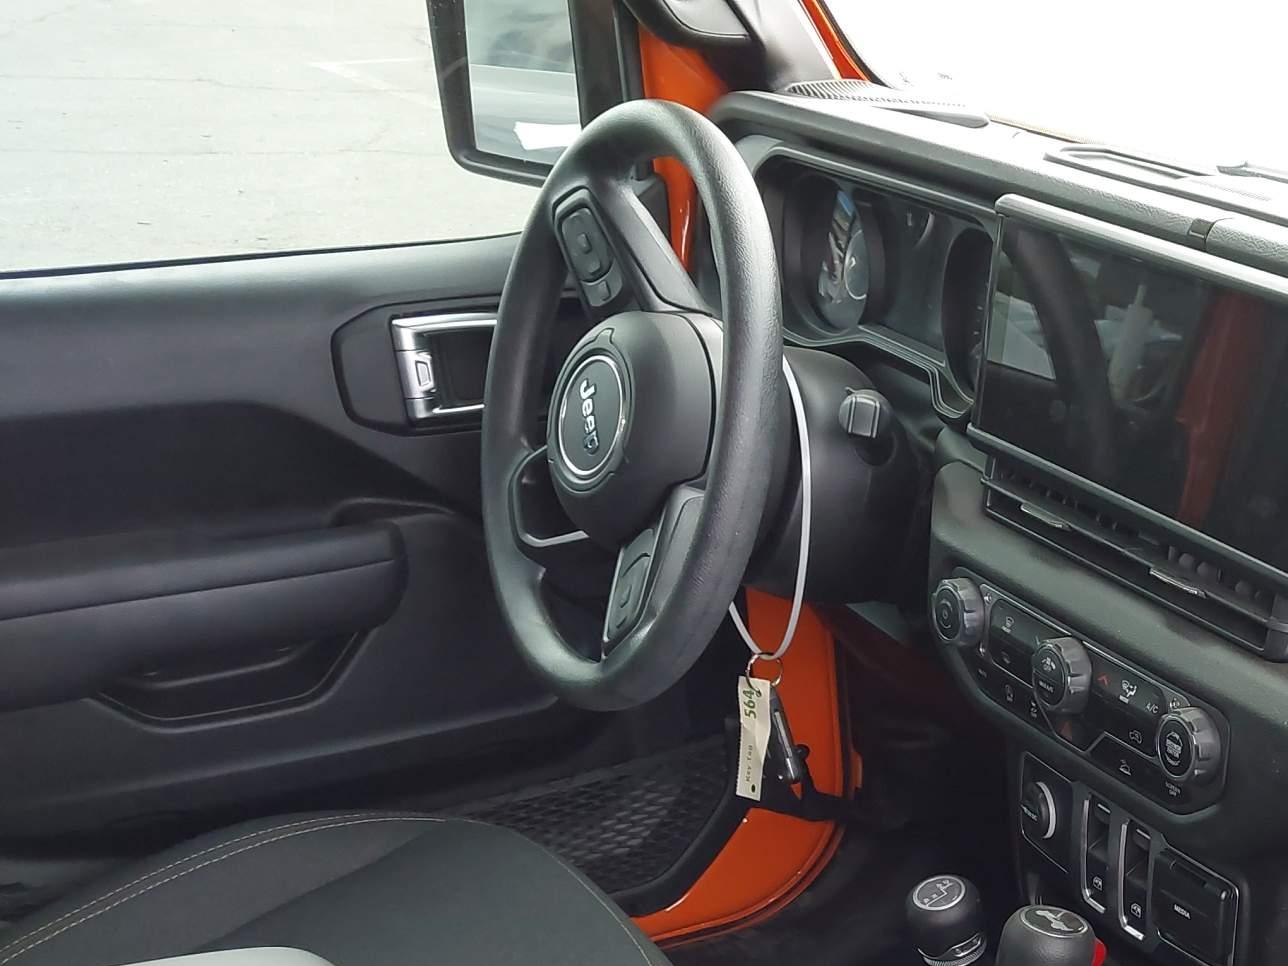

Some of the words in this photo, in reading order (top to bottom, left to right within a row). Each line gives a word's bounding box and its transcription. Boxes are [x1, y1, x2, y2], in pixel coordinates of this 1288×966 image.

[579, 379, 600, 456] Jeep
[742, 688, 758, 720] 564
[1145, 702, 1160, 714] A/C
[1173, 903, 1191, 920] MEDIA
